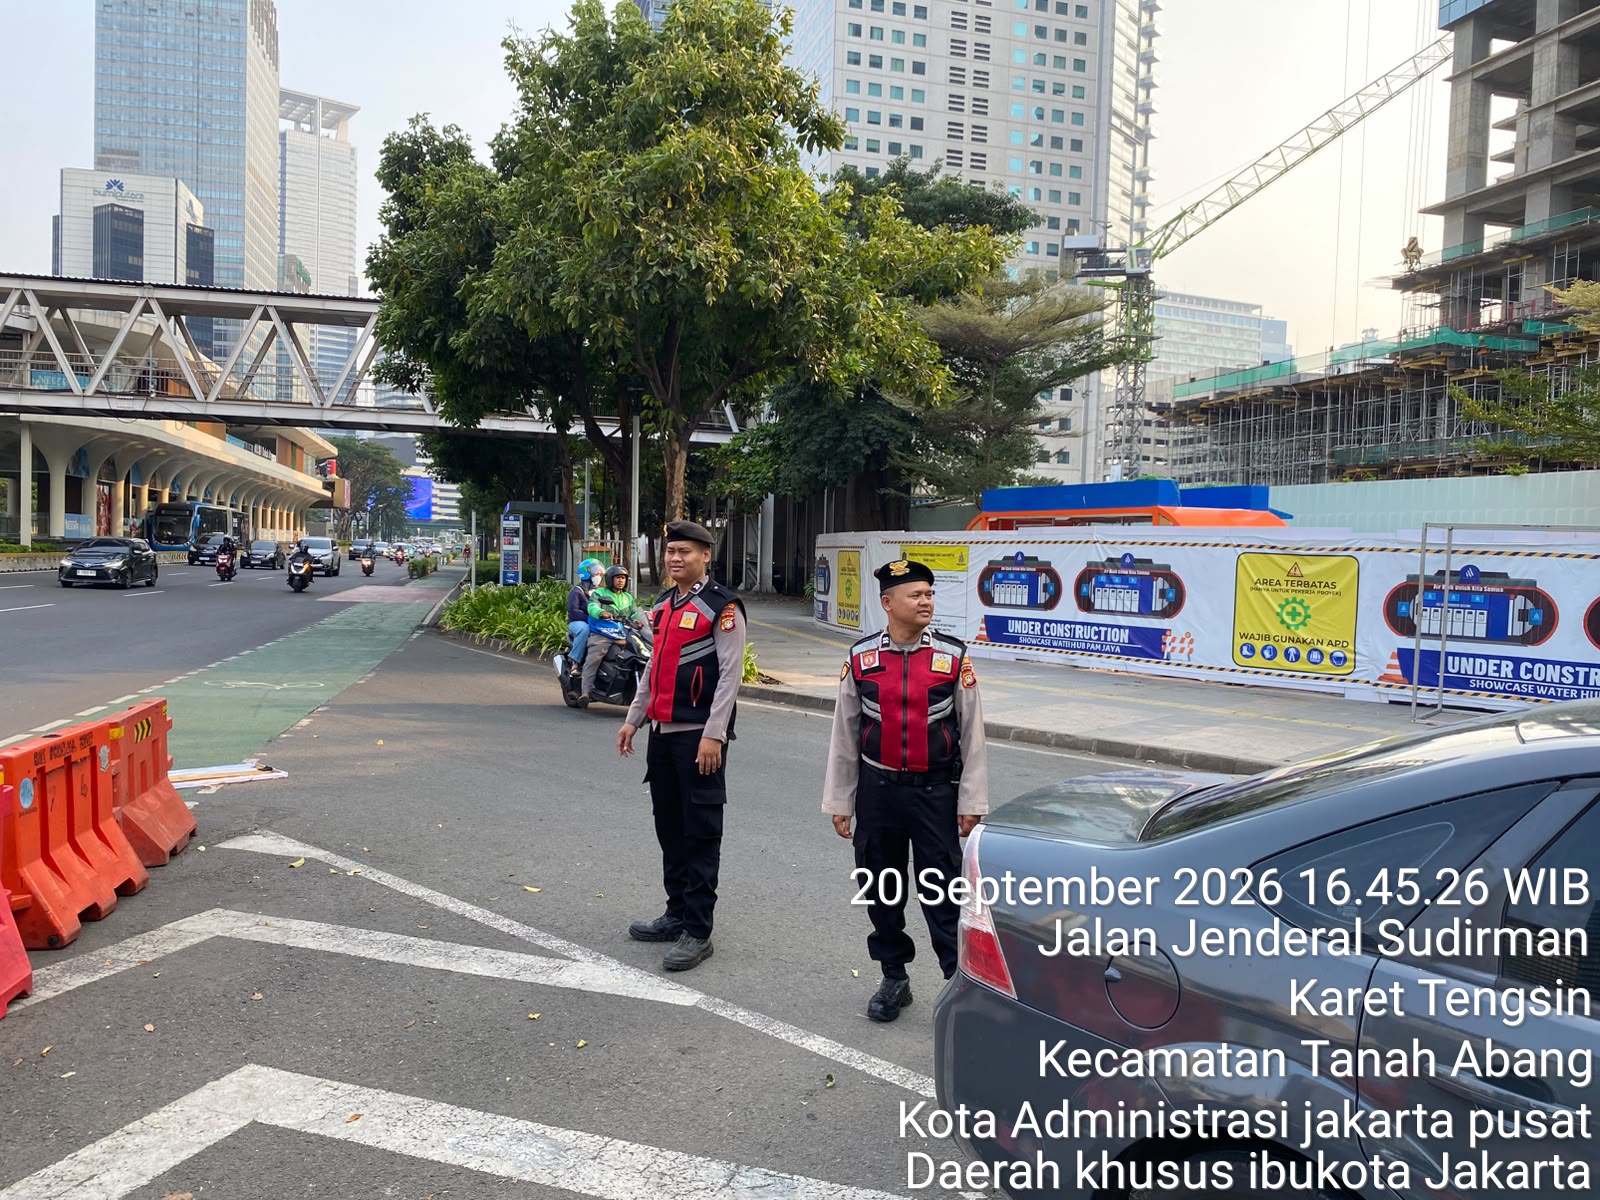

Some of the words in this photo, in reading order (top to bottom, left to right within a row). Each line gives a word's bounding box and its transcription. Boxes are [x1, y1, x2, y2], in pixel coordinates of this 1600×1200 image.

[1255, 578, 1281, 587] AREA
[1284, 580, 1337, 589] TERBATAS
[1008, 620, 1041, 635] UNDER
[1044, 622, 1129, 643] CONSTRUCTION
[1239, 632, 1270, 641] WAJIB
[1272, 634, 1324, 646] GUNAKAN
[1326, 640, 1349, 648] APD
[1019, 636, 1051, 646] SHOWCASE
[1070, 642, 1086, 650] HUB
[1102, 644, 1120, 653] JAYA
[1448, 656, 1514, 678] UNDER
[1520, 662, 1600, 686] CONSTR
[1470, 680, 1534, 694] SHOWCASE
[1536, 685, 1578, 698] WATER
[1581, 690, 1600, 699] HU
